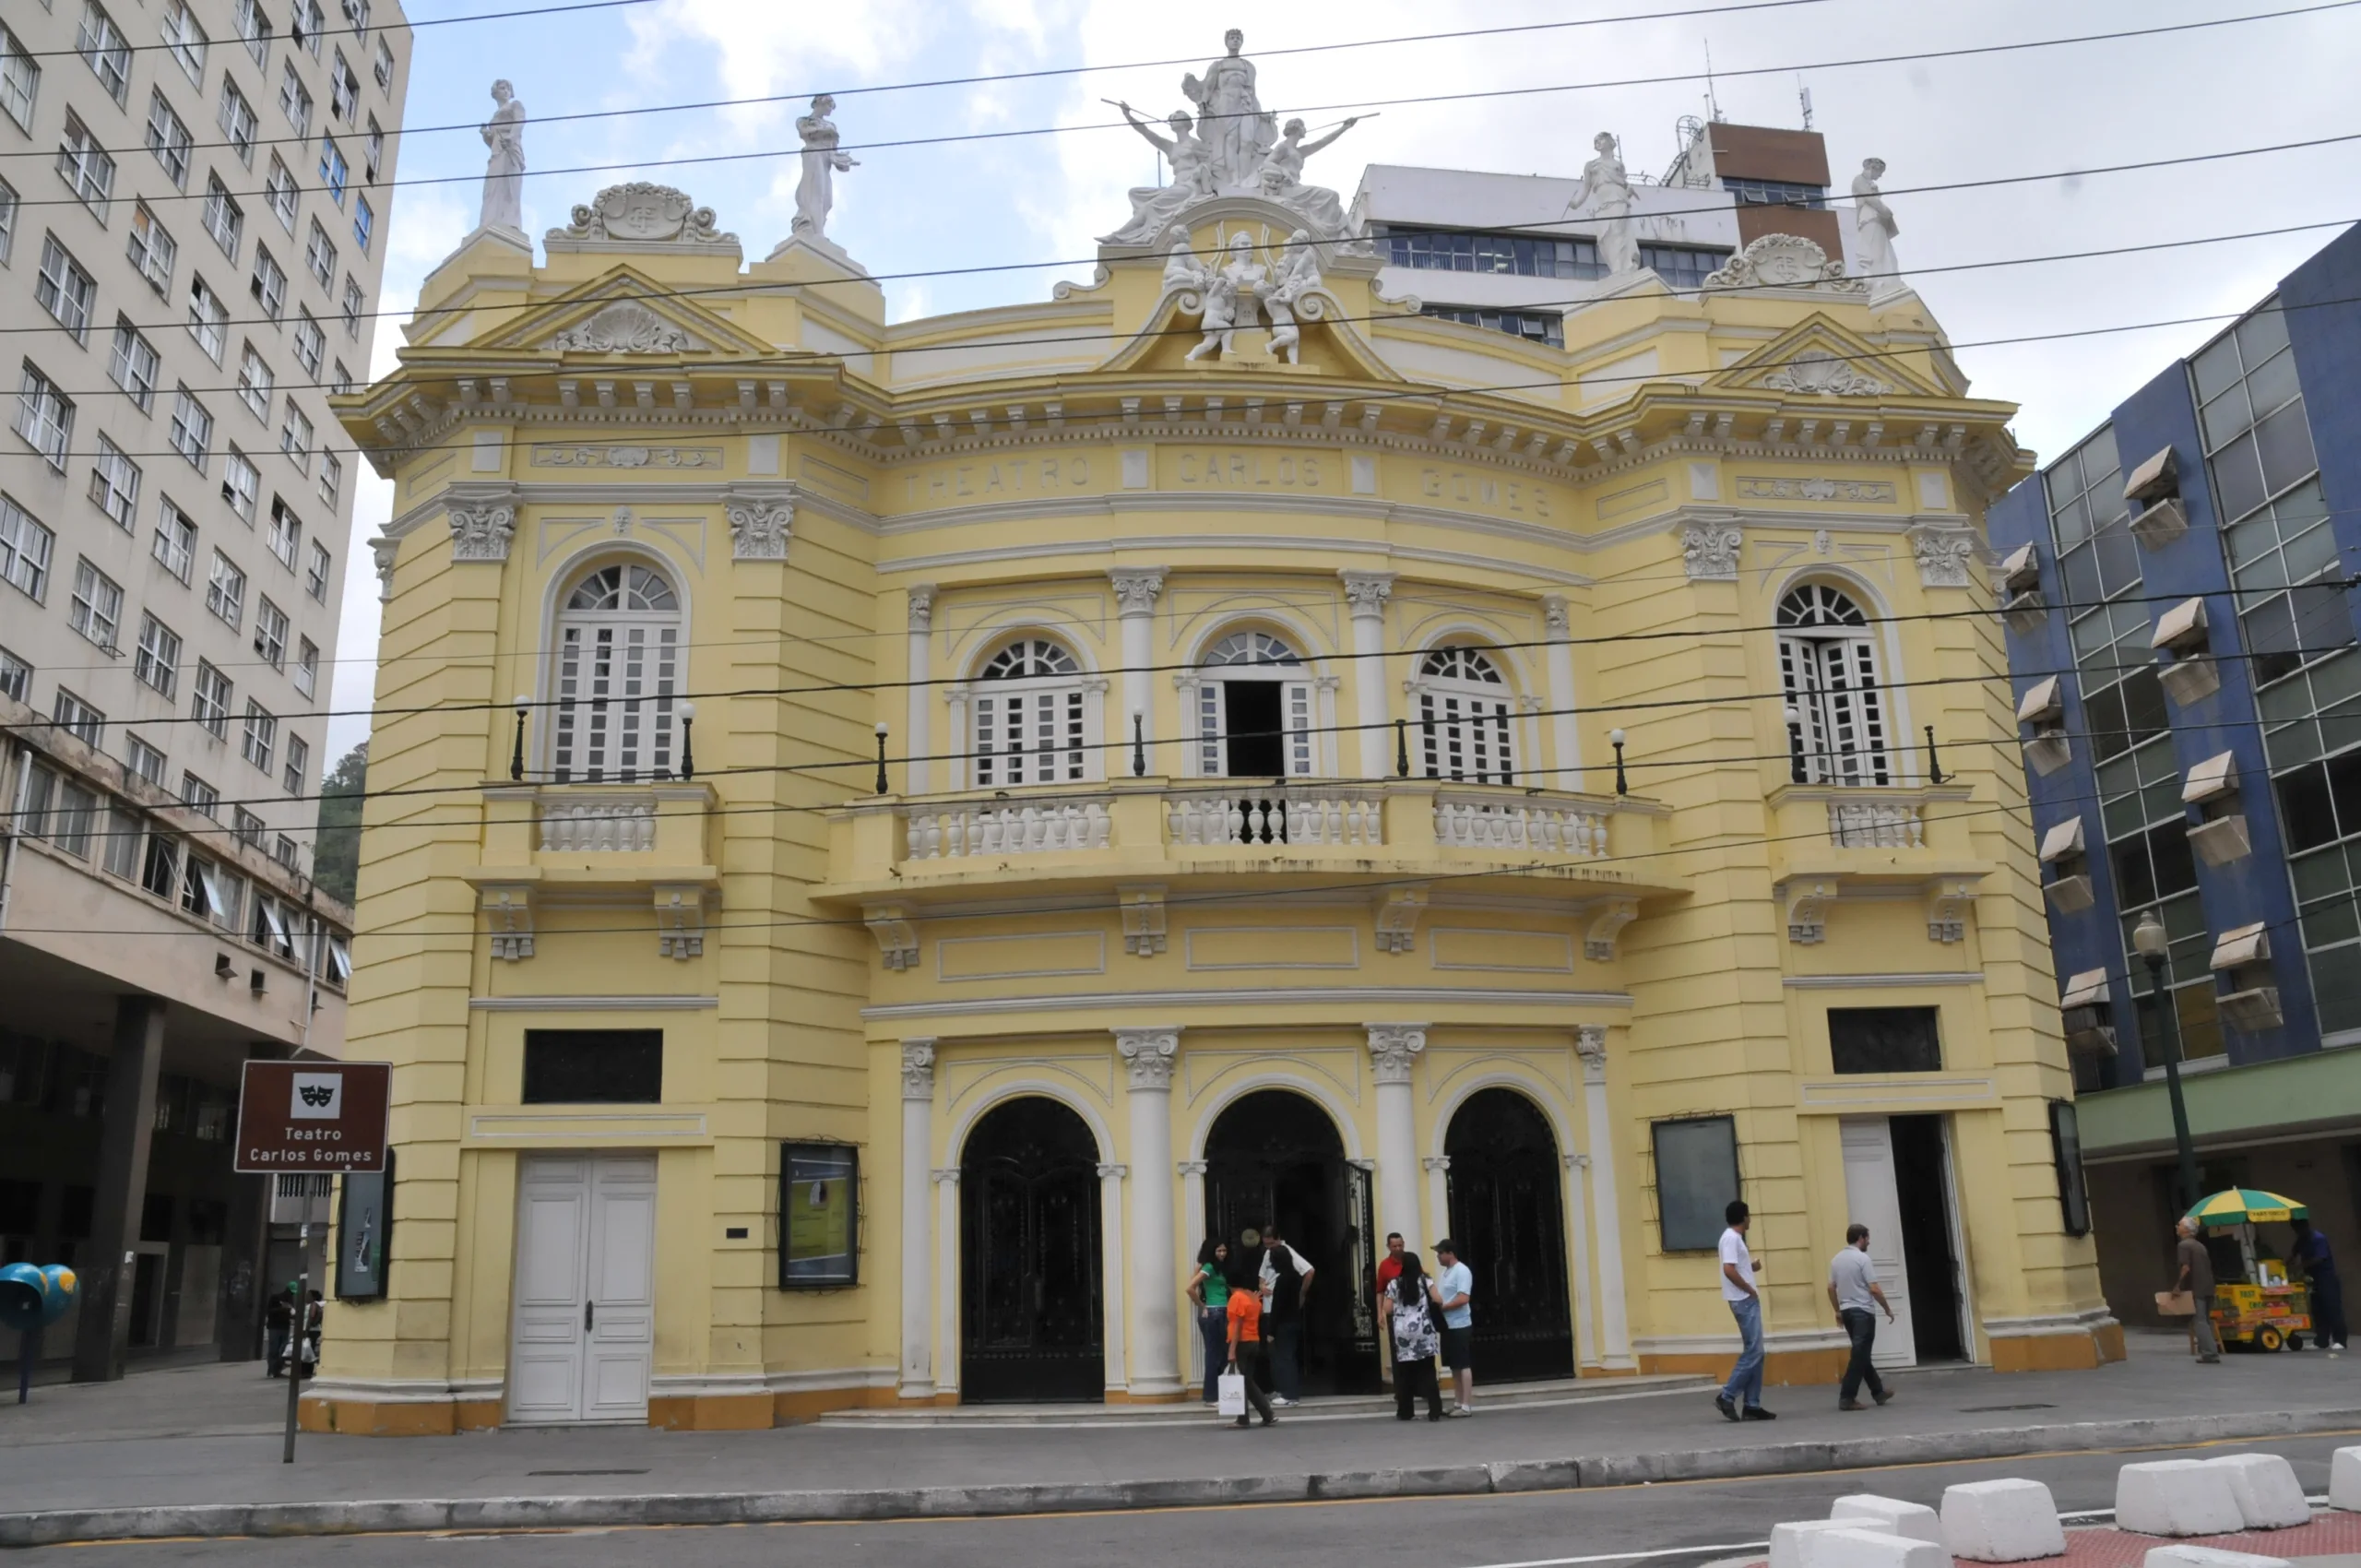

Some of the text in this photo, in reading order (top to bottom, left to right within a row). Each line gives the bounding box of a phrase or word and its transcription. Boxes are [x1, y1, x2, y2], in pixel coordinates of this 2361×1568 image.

[905, 453, 1550, 517] THEATRO CARLOS GOMES
[285, 1127, 341, 1140] Teatro
[250, 1148, 372, 1162] Carlos Gomes
